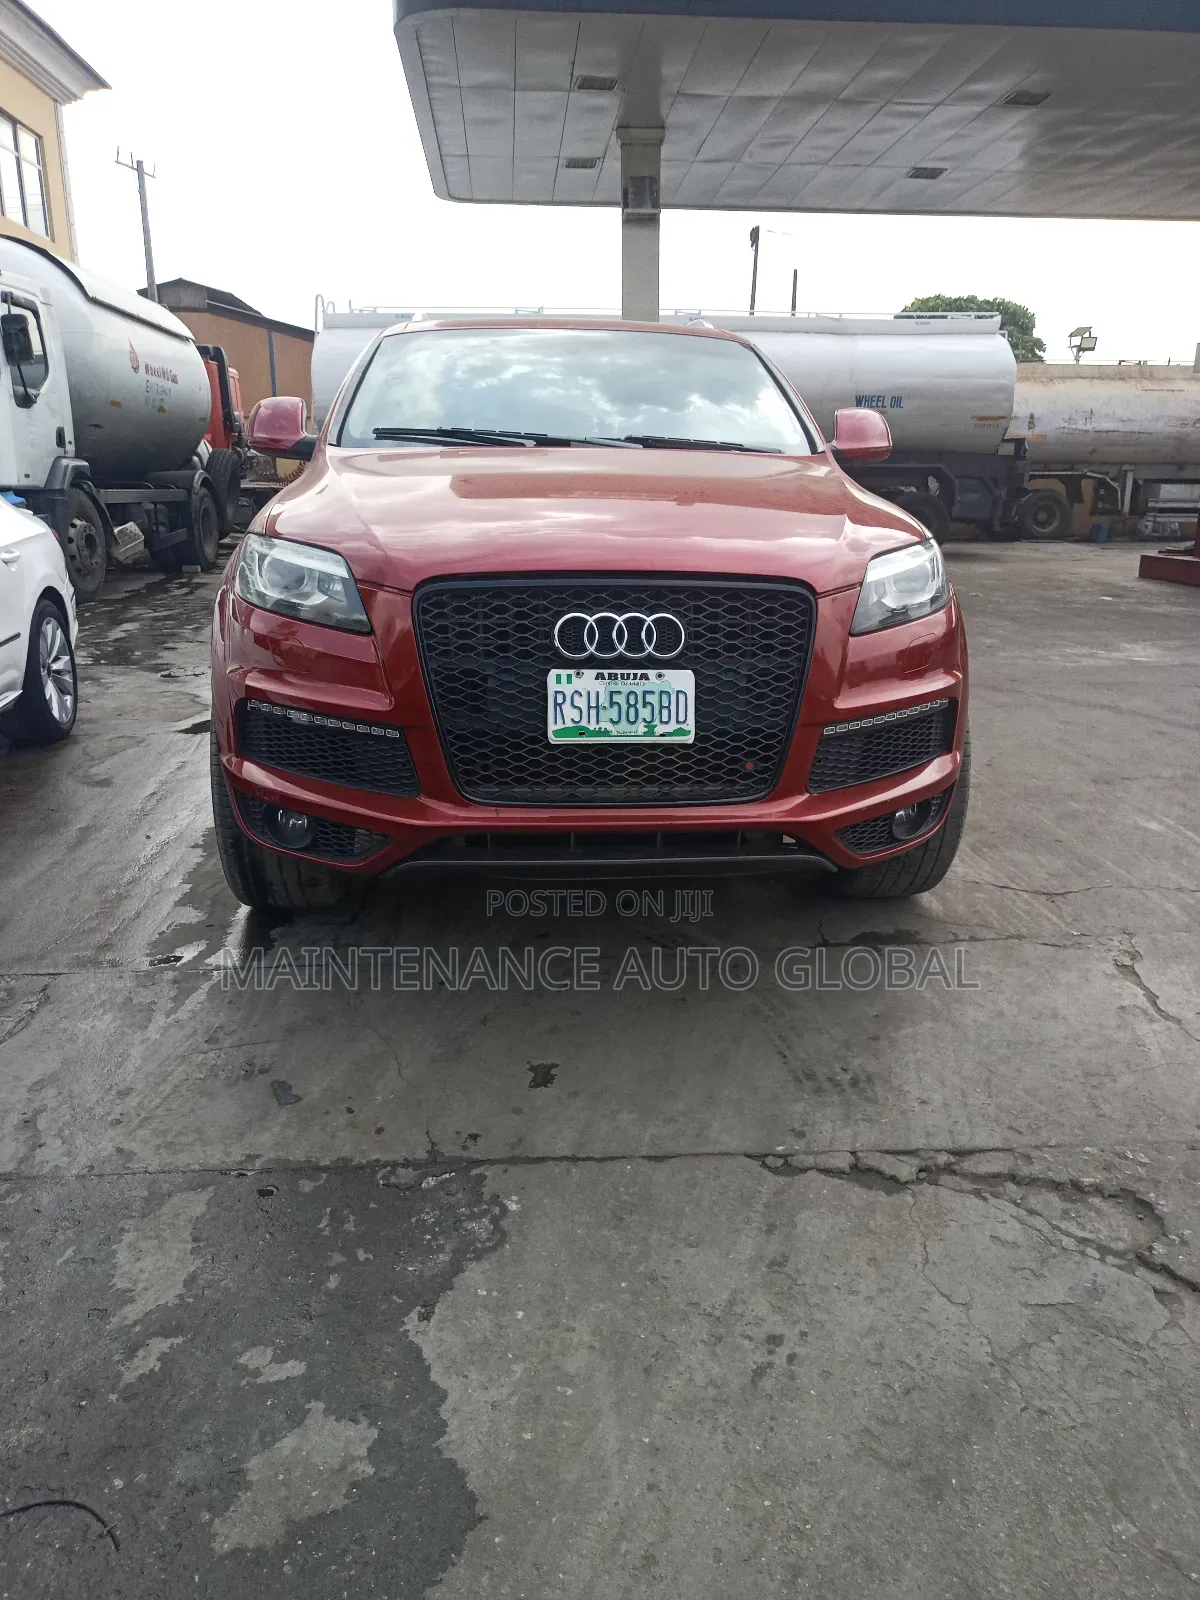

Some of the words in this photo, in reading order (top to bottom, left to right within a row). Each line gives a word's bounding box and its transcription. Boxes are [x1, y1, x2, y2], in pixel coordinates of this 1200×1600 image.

[855, 395, 887, 408] WHEEL
[890, 396, 904, 408] OIL
[594, 671, 650, 681] ABUJA
